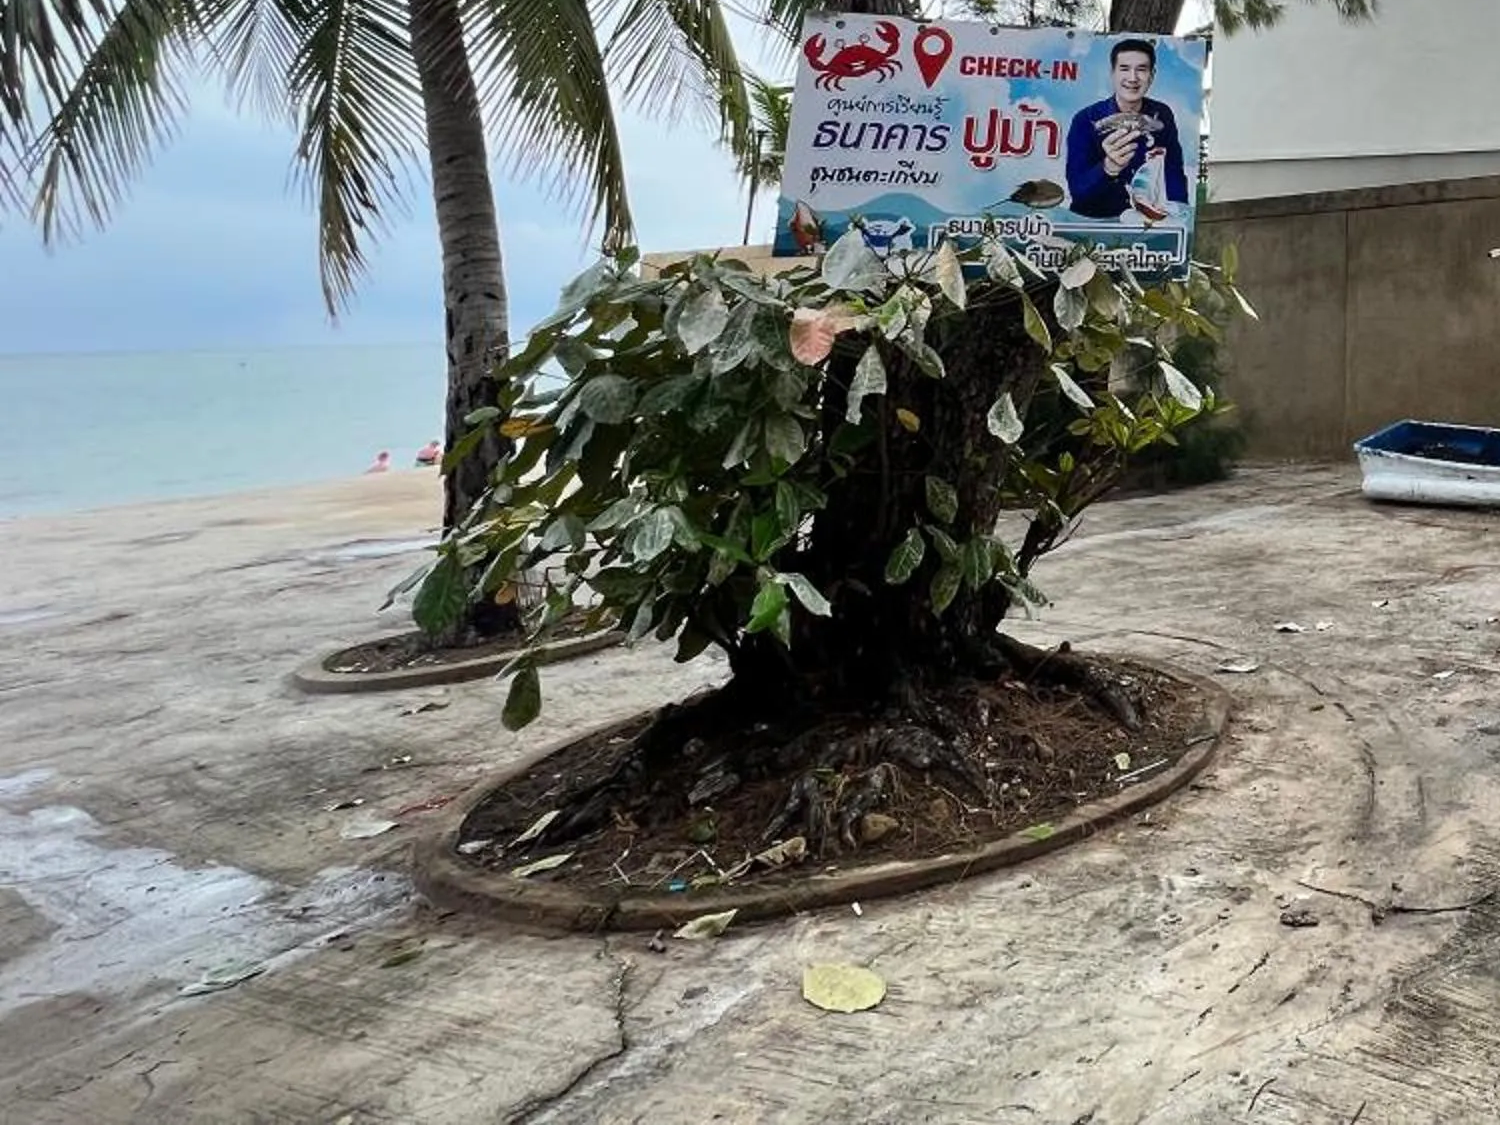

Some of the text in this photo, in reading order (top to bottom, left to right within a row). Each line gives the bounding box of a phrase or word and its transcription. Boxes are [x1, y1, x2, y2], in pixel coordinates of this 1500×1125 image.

[958, 54, 1080, 82] CHECK-IN
[826, 93, 952, 121] ศูนย์การเรียนรู้
[811, 103, 1061, 169] ธนาคาร ปูม้า
